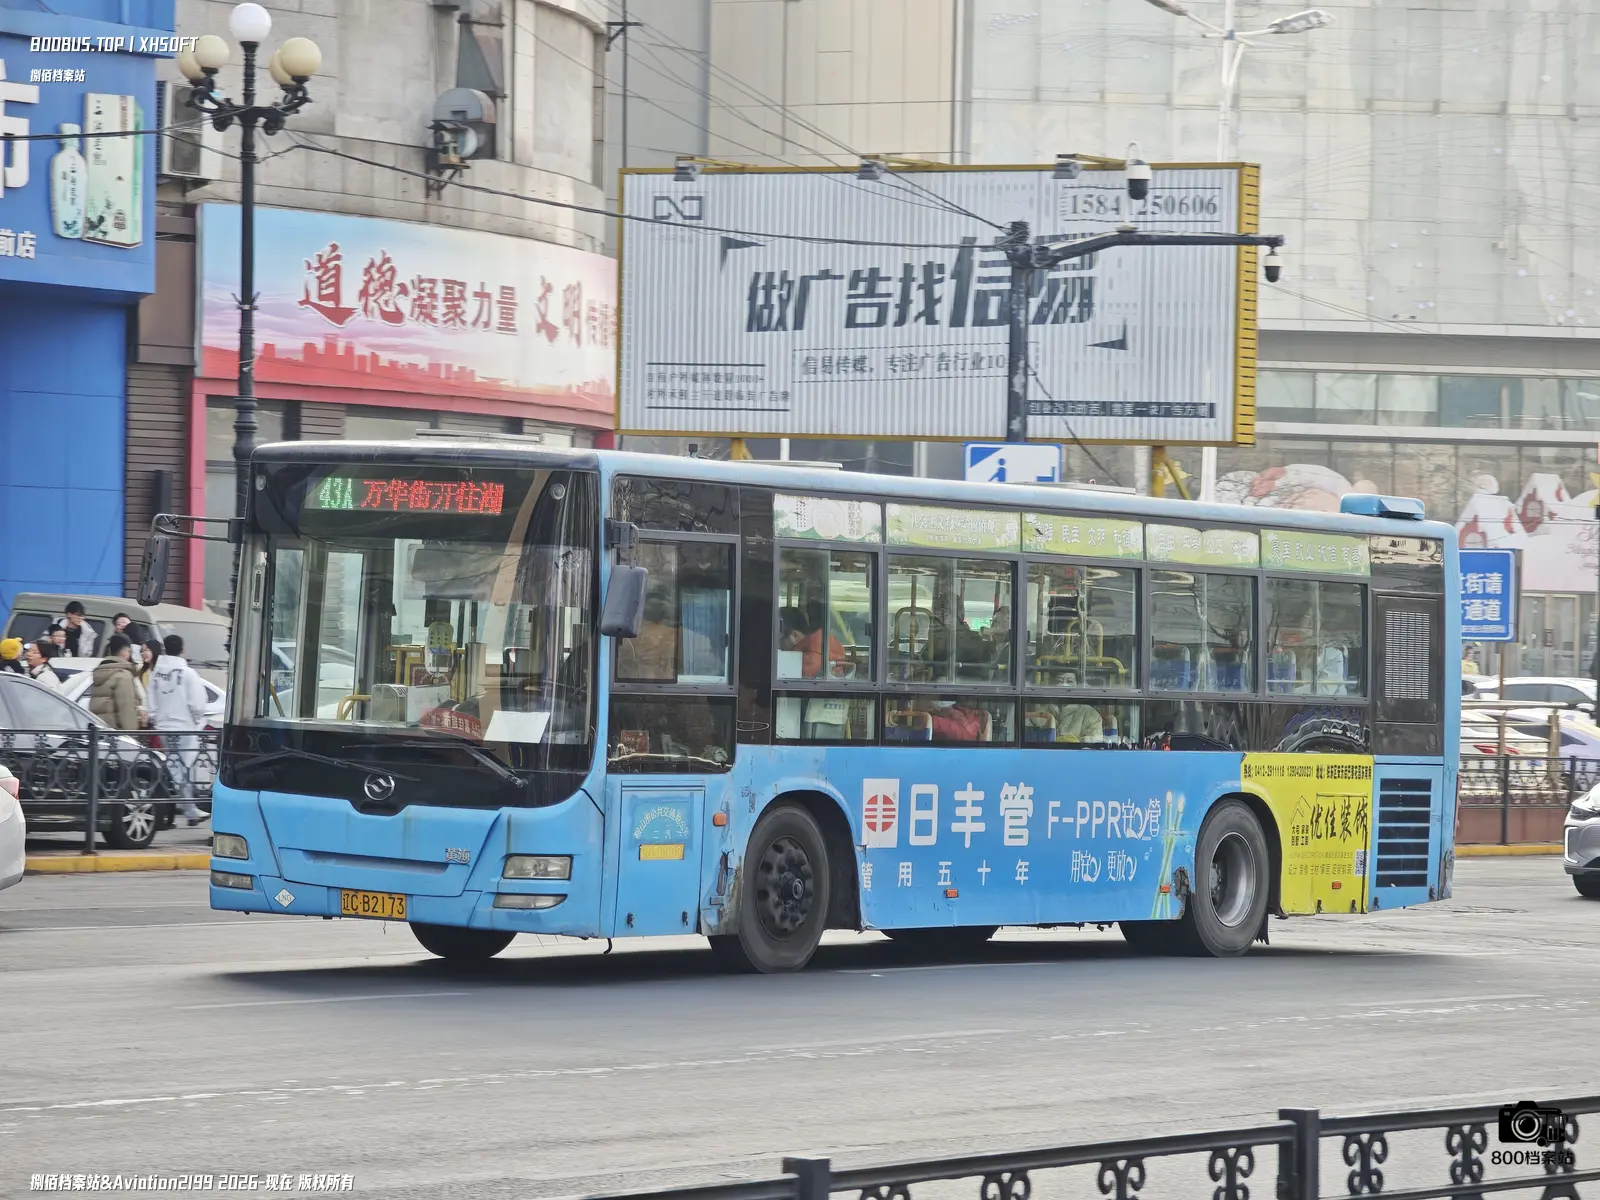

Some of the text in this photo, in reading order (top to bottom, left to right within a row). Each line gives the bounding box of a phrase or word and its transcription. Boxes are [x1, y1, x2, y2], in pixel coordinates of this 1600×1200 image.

[299, 241, 519, 335] 道德凝聚力量
[1460, 571, 1504, 595] 街请
[1461, 598, 1502, 621] 通道
[909, 782, 1035, 849] 日丰管
